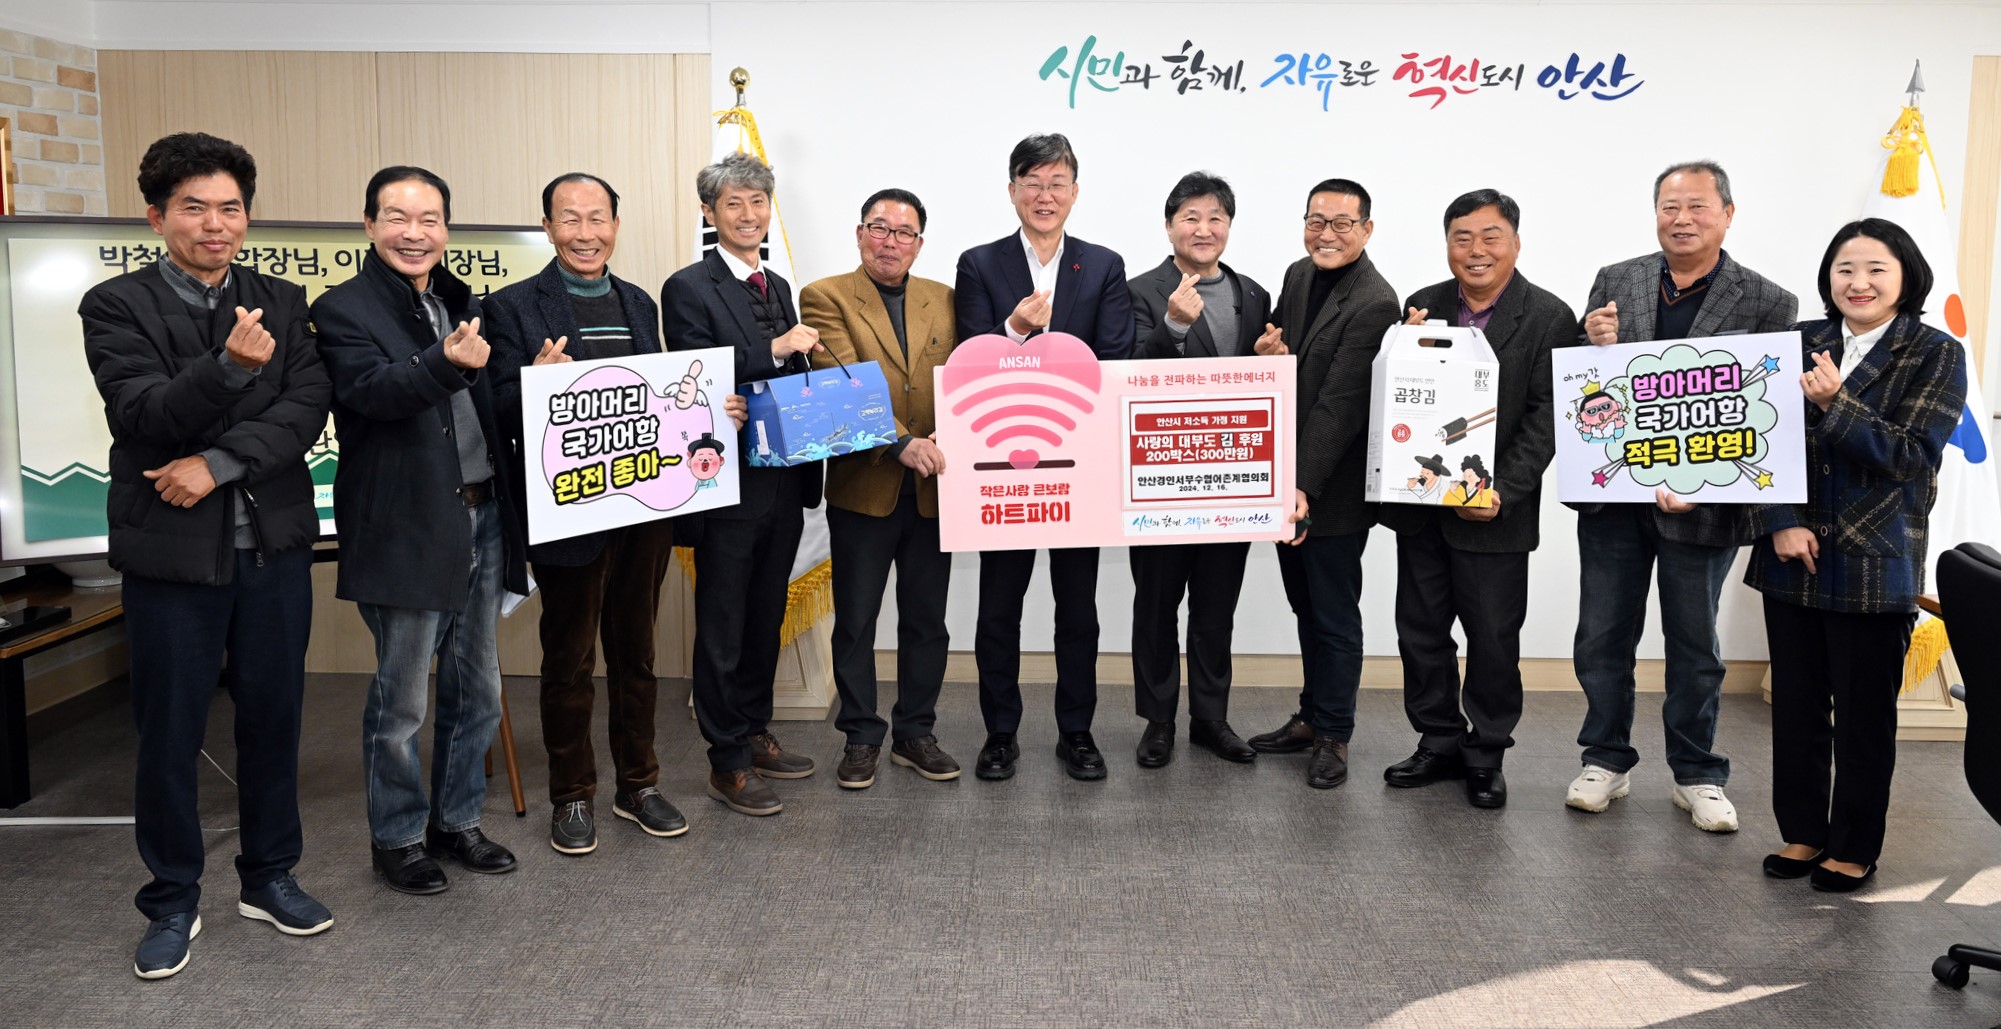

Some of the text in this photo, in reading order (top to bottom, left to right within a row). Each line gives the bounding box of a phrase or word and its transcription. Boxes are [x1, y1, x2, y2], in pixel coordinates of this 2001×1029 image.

[1038, 35, 1645, 112] 시민과 함께, 자유로운 혁신도시 안산
[99, 244, 162, 274] 박철
[235, 247, 328, 277] 합장님,
[999, 355, 1041, 369] ANSAN
[1128, 371, 1276, 386] 나눔을 전파하는 따뜻한에너지
[1563, 373, 1574, 382] oh
[1631, 363, 1742, 401] 방아머리
[549, 383, 648, 426] 방아머리
[1393, 387, 1436, 405] 곱창김
[1156, 415, 1248, 427] 안산시 저소득 가정 지원
[1635, 396, 1748, 431] 국가어항
[562, 414, 660, 459] 국가어항
[1136, 433, 1264, 450] 사랑의 대부도 김 후원
[1145, 448, 1254, 463] 200박스(300만원)
[1624, 428, 1756, 468] 적극 환영!
[553, 461, 606, 505] 완전
[979, 483, 1070, 497] 작은사랑 큰보람
[1178, 485, 1200, 493] 2024.
[1217, 484, 1229, 492] 16.
[981, 501, 1071, 525] 하트파이
[1247, 512, 1273, 525] 안산
